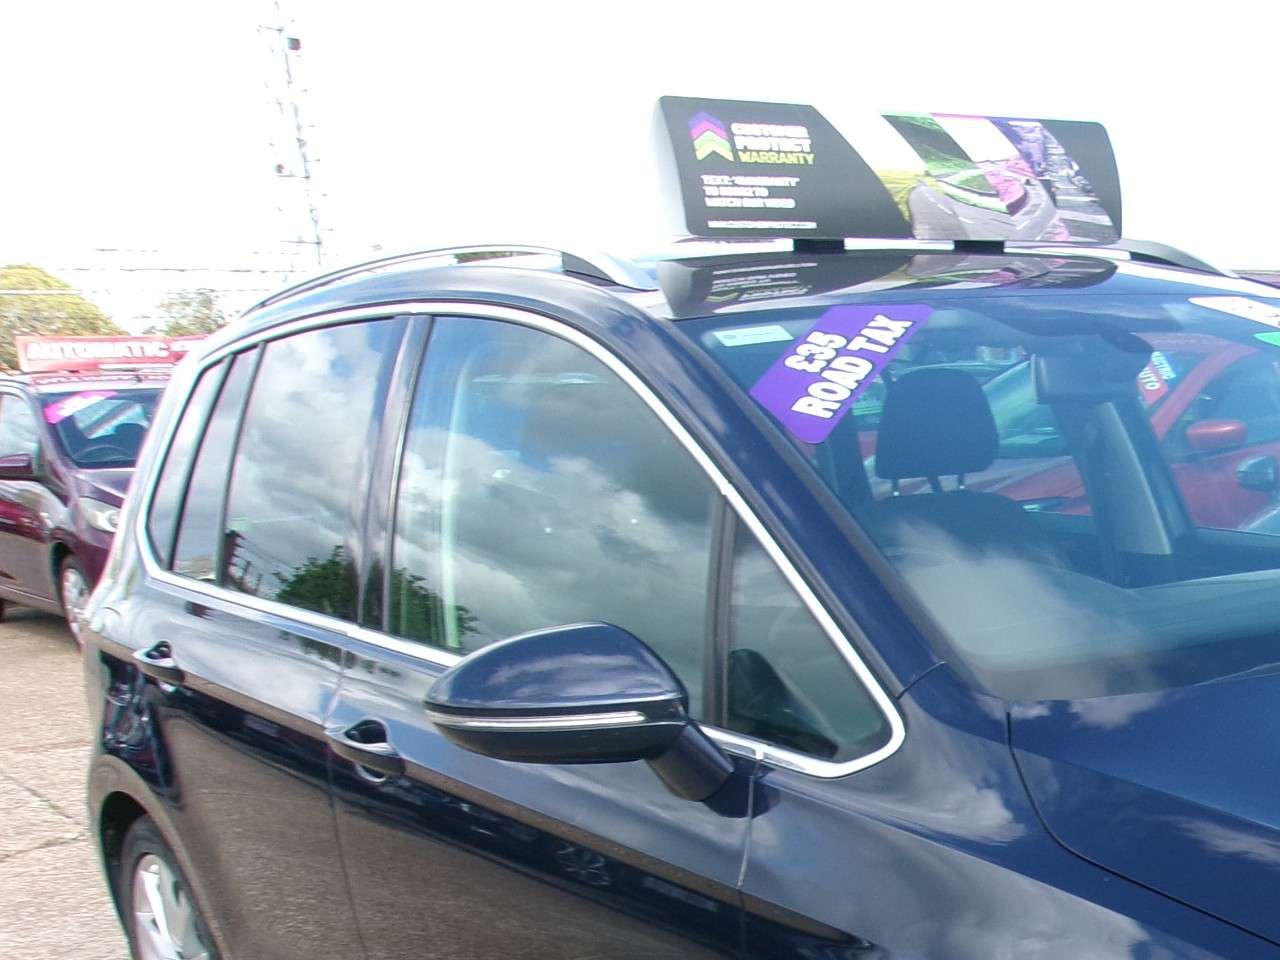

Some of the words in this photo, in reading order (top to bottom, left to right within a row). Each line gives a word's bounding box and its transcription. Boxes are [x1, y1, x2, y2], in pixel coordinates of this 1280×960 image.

[738, 151, 815, 165] WARRANTY
[27, 342, 170, 361] AUTOMATIC
[784, 330, 849, 374] £35
[791, 355, 873, 419] ROAD
[846, 314, 914, 354] TAX
